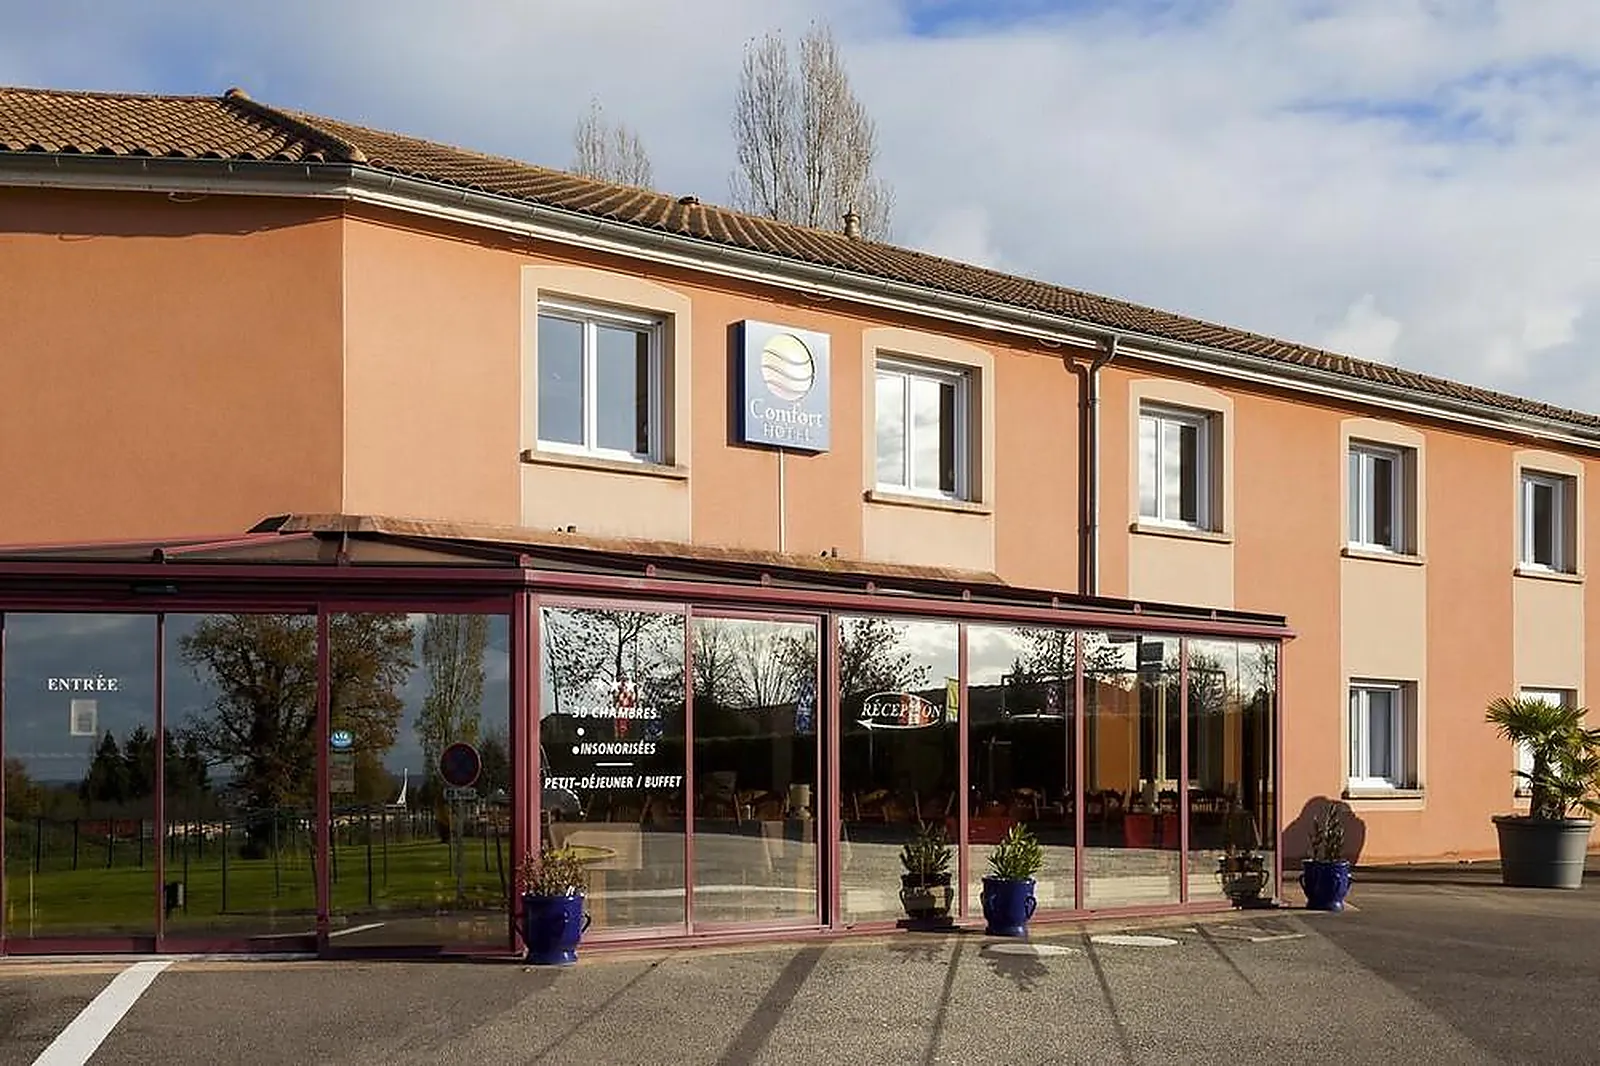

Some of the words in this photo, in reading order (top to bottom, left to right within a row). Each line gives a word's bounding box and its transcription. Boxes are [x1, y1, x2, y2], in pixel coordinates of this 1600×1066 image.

[750, 399, 823, 427] Comfort
[48, 674, 118, 691] ENTRÉE
[592, 706, 657, 719] CHAMBRES
[861, 699, 943, 718] RÉCEPON
[580, 740, 656, 755] INSONORISÉES
[544, 774, 634, 789] PETIT-DÉJEUNER
[644, 775, 683, 788] BUFFET
